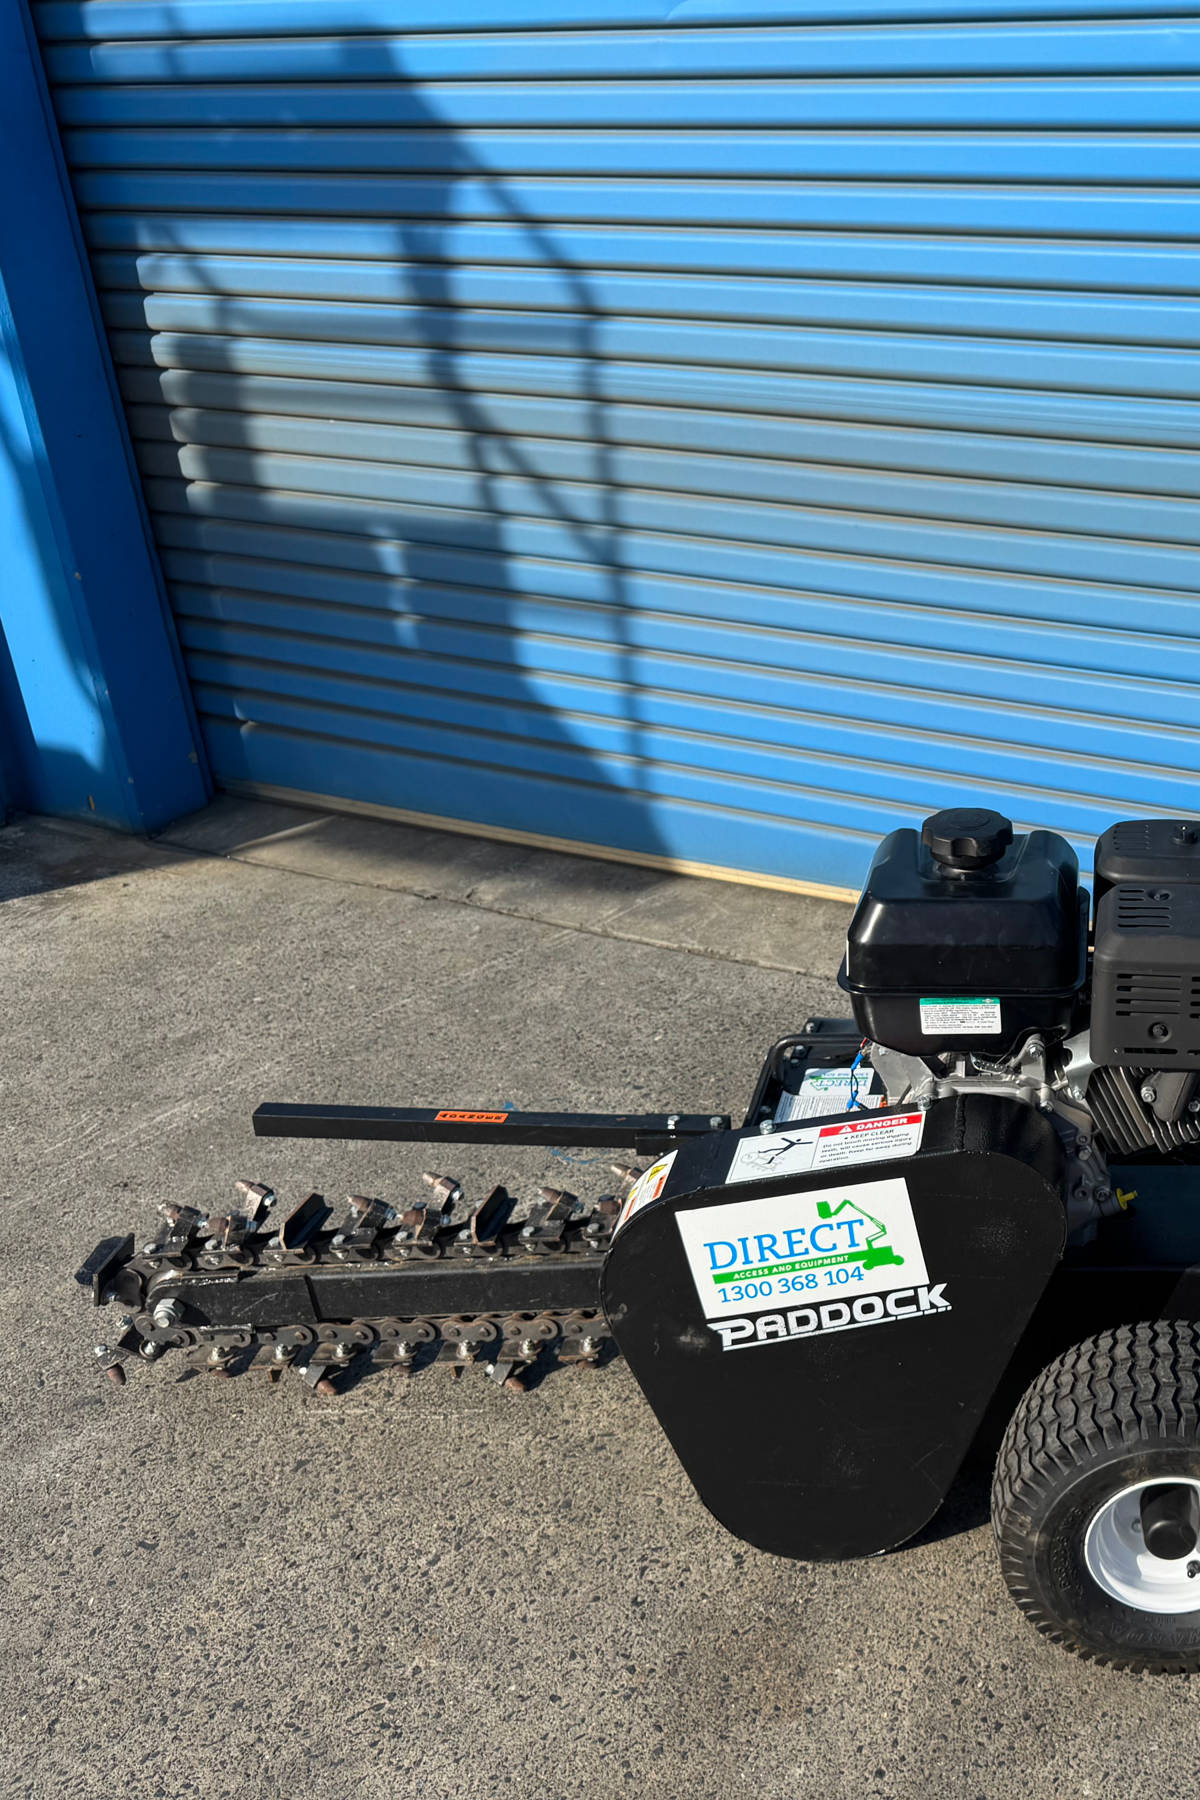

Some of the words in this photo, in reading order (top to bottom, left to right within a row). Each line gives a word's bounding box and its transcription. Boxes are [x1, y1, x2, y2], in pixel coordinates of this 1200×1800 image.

[850, 1132, 869, 1140] KEEP
[870, 1129, 895, 1137] CLEAR
[856, 1118, 908, 1130] DANGER
[703, 1219, 864, 1270] DIRECT
[733, 1268, 769, 1280] ACCESS
[772, 1265, 793, 1274] AND
[795, 1255, 849, 1270] EQUIPMENT
[718, 1281, 773, 1303] 1300
[777, 1273, 818, 1294] 368
[824, 1266, 864, 1286] 104
[706, 1282, 952, 1350] PADDOCK
